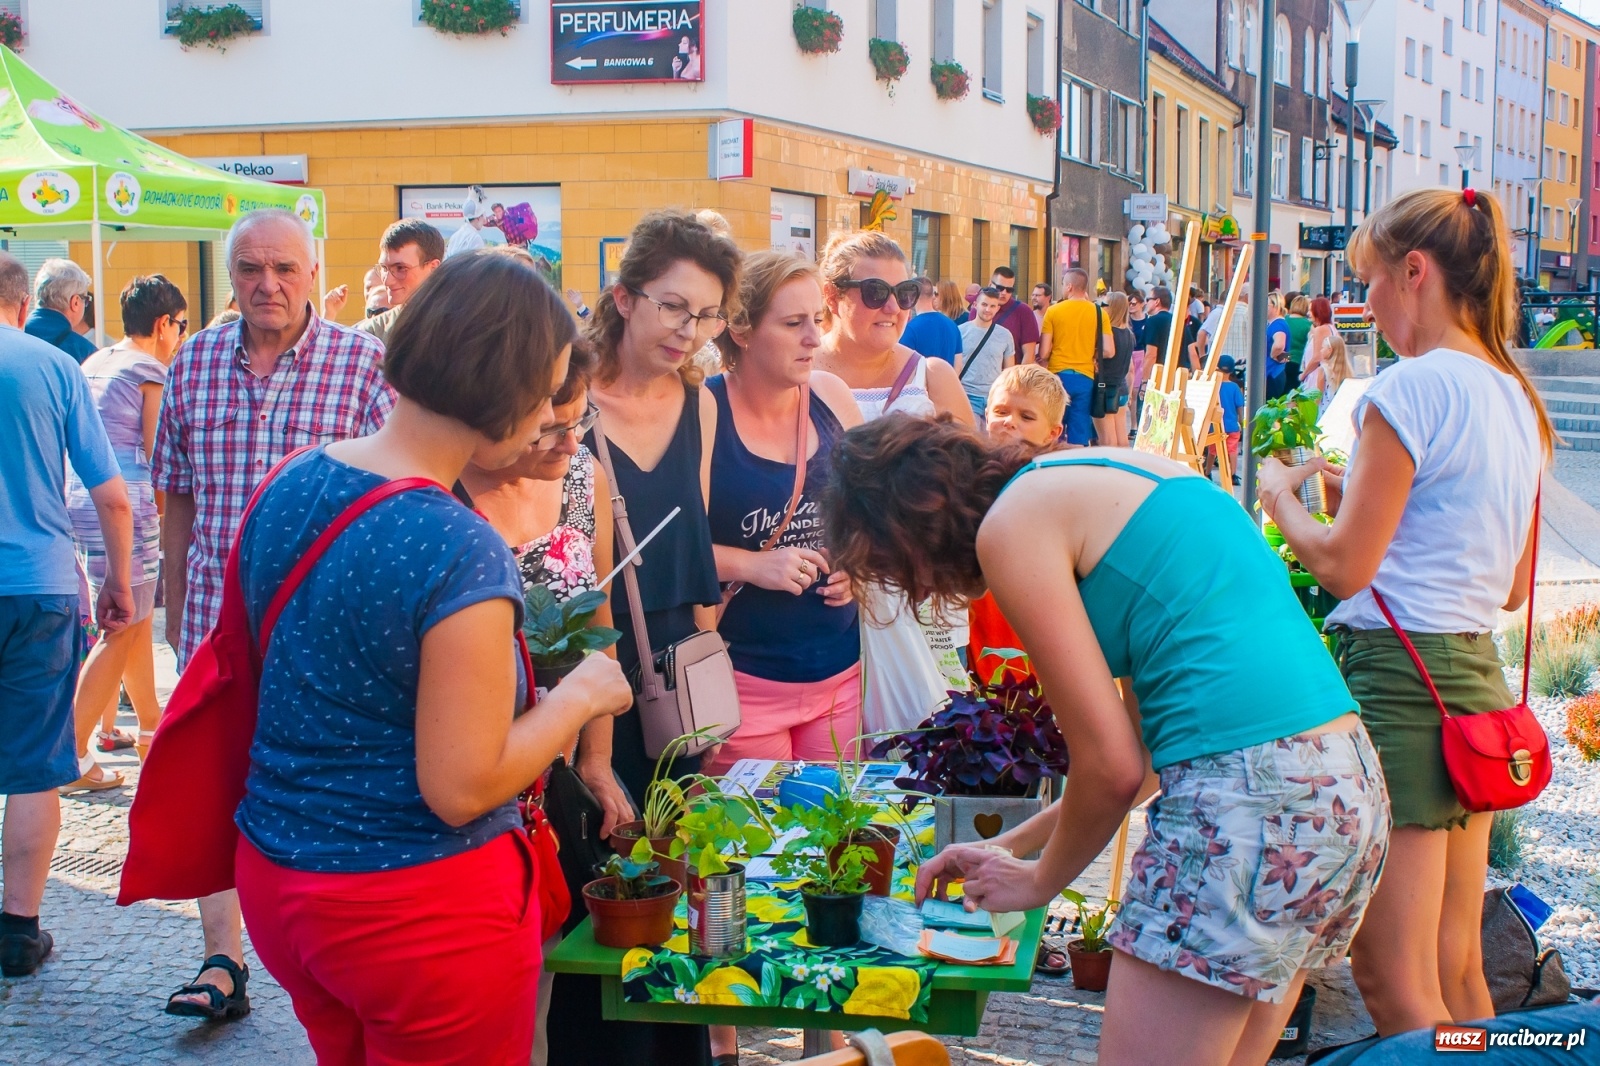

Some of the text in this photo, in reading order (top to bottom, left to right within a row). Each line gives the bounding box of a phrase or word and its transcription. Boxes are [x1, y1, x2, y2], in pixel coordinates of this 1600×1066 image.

[560, 9, 692, 33] PERFUMERIA
[603, 57, 654, 67] BANKOWA 6
[234, 162, 274, 176] Pekao
[426, 202, 443, 210] Bank
[741, 507, 781, 539] The
